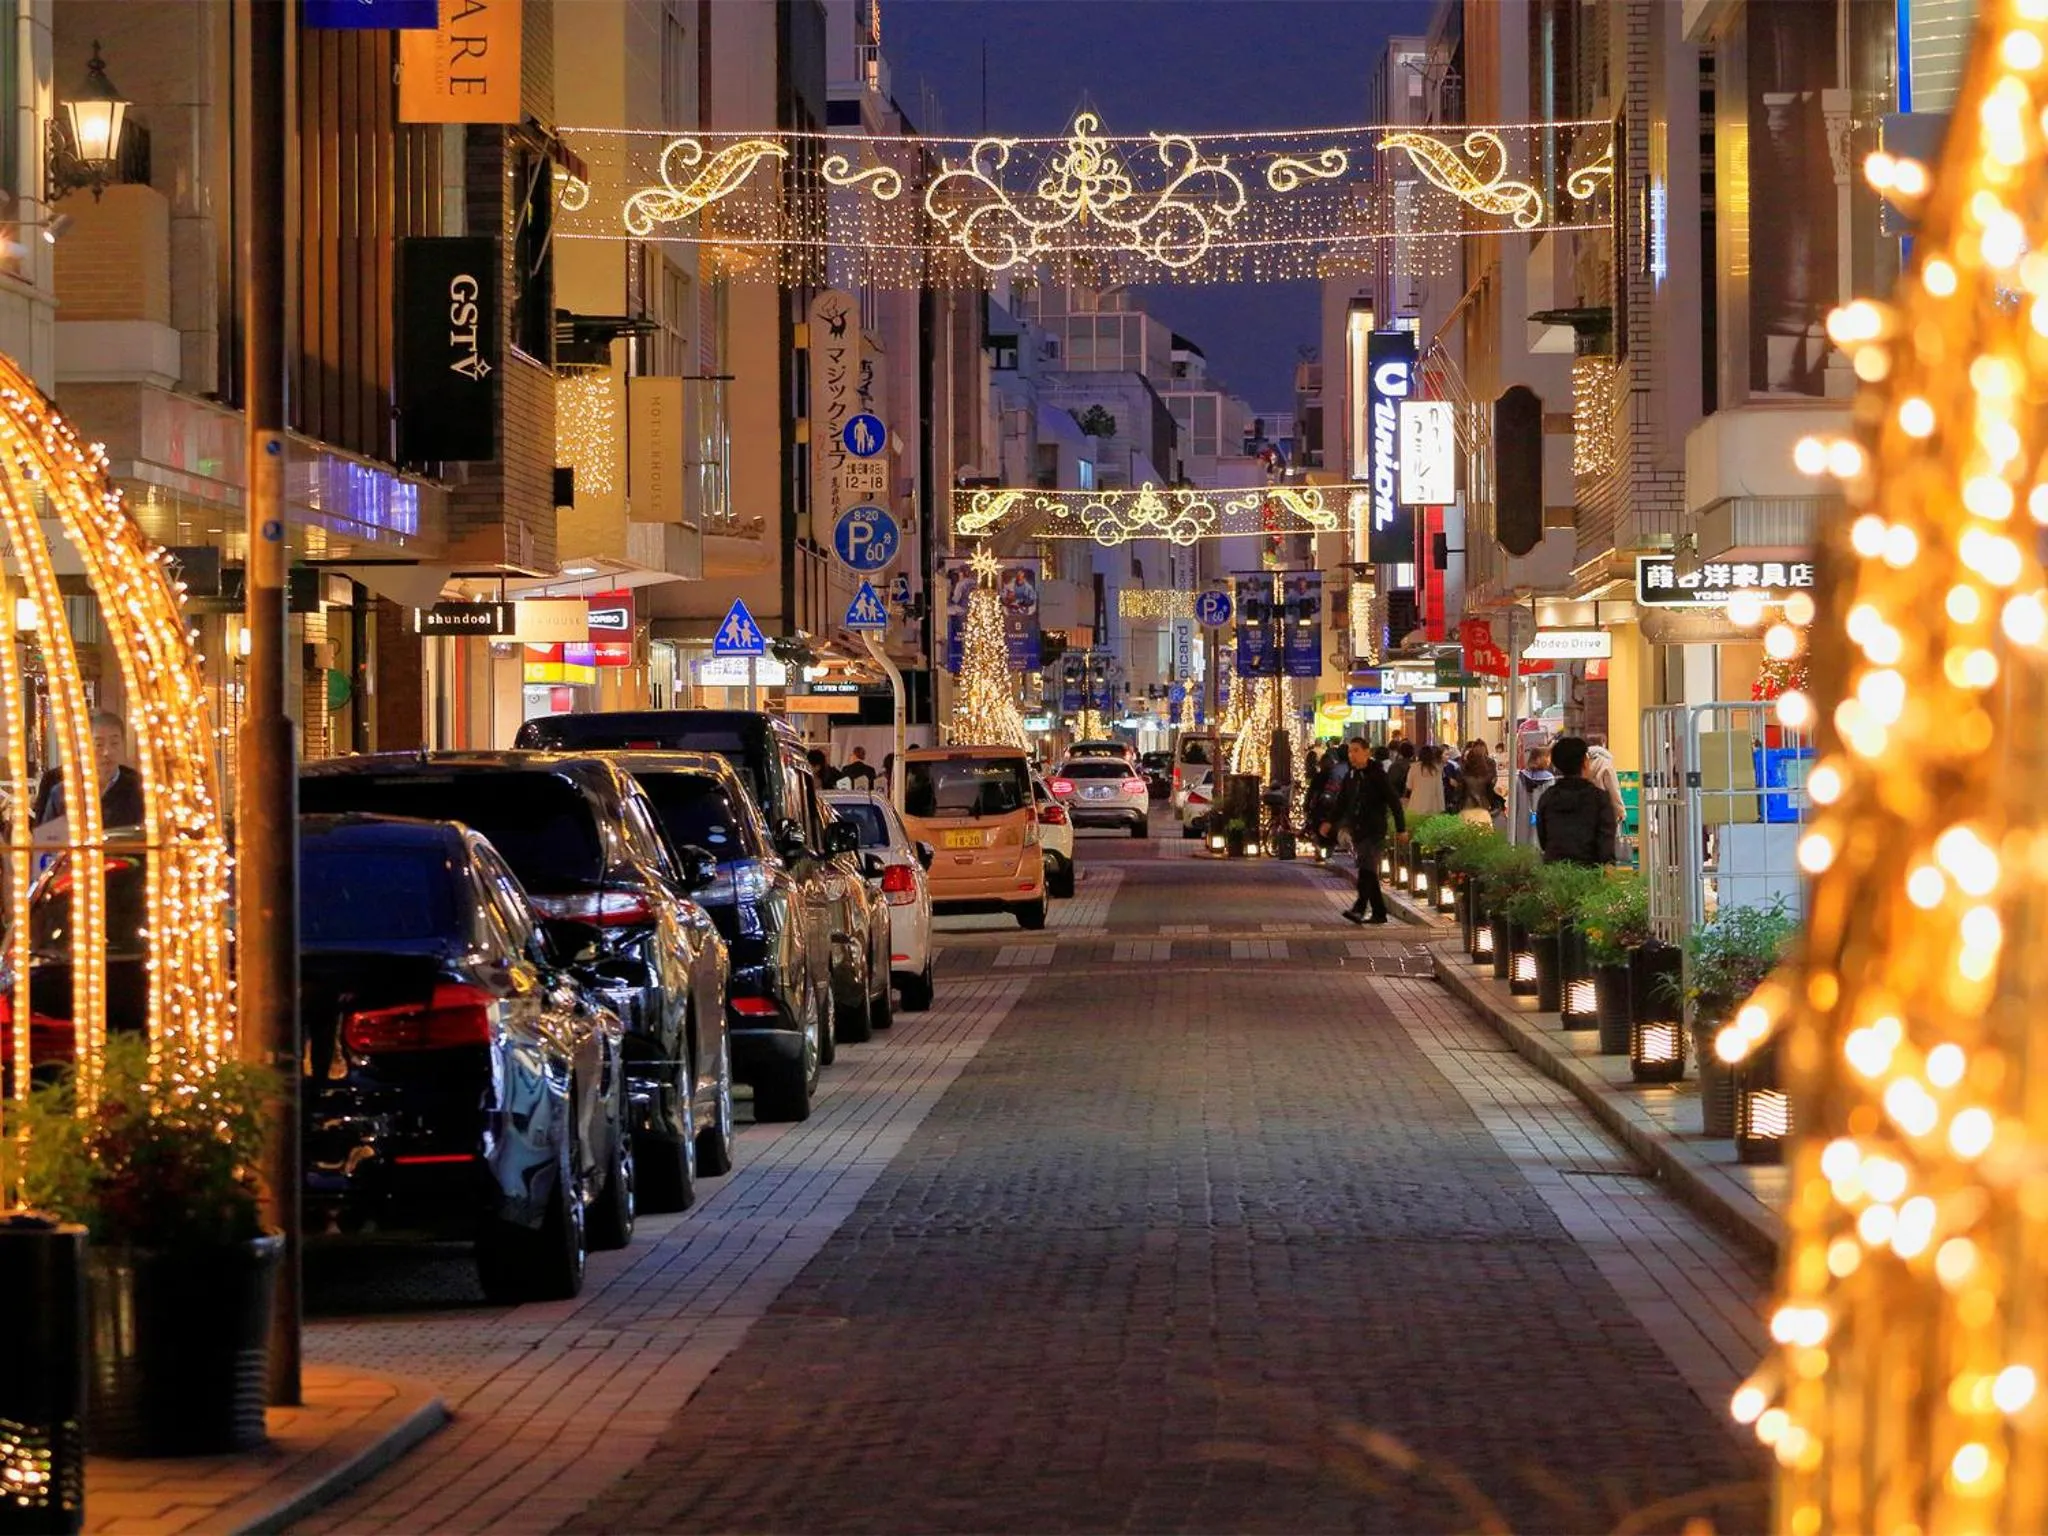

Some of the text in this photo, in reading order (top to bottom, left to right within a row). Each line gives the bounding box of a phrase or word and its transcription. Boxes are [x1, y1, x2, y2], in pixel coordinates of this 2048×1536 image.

[450, 274, 478, 381] GSTV
[846, 476, 883, 488] 12-18
[854, 511, 879, 521] 8-20
[849, 521, 873, 560] P
